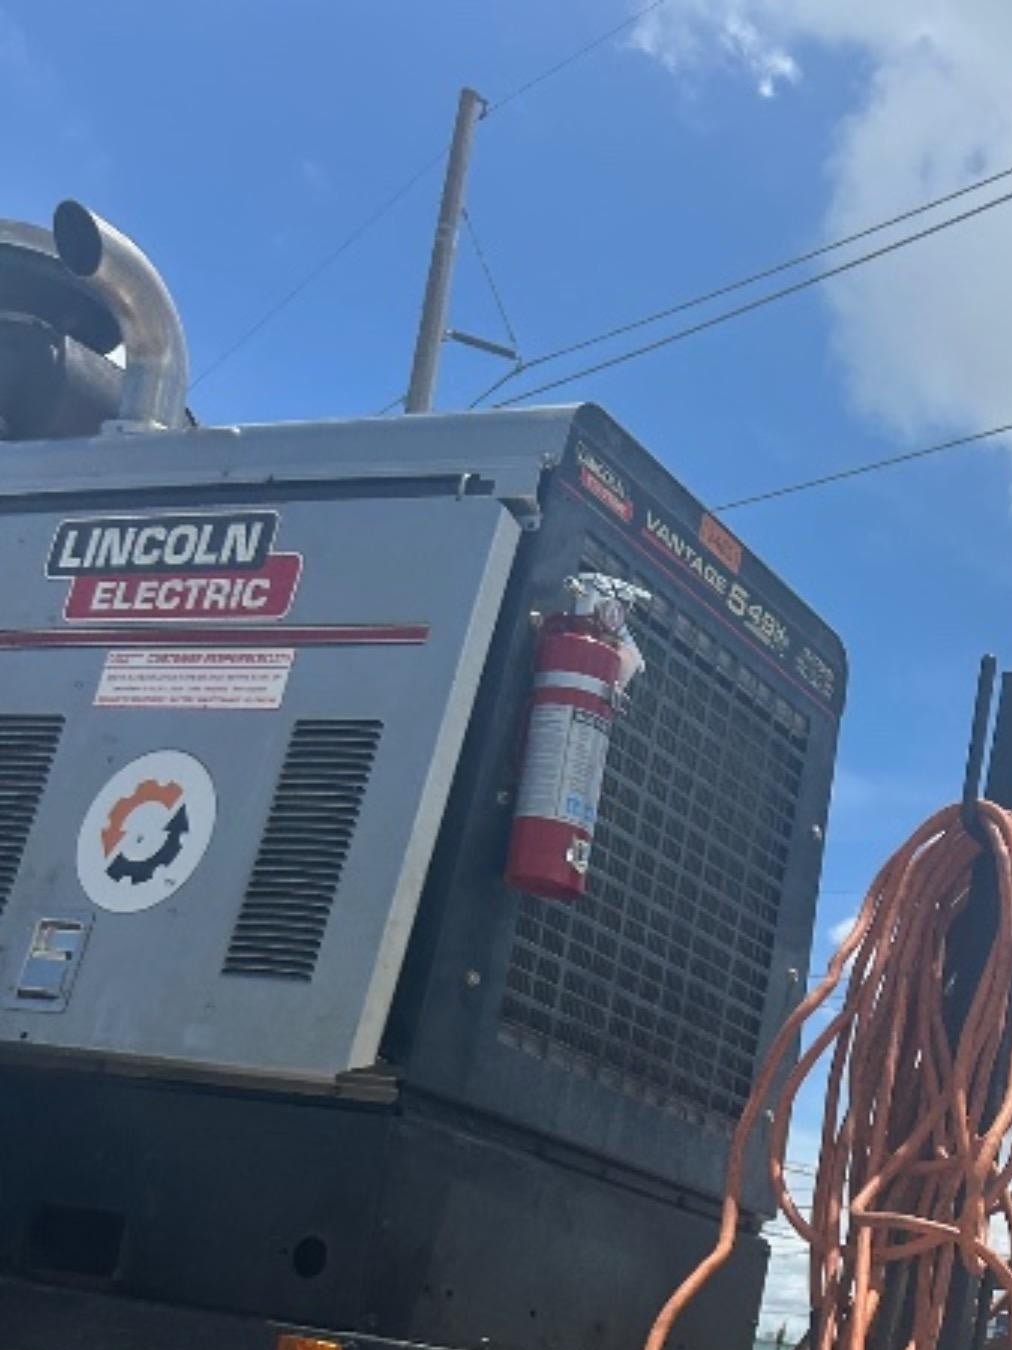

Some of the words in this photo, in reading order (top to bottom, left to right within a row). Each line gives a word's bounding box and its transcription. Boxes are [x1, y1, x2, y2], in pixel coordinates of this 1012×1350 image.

[58, 521, 265, 568] LINCOLN
[646, 509, 728, 596] VANTAGE
[90, 578, 271, 611] ELECTRIC
